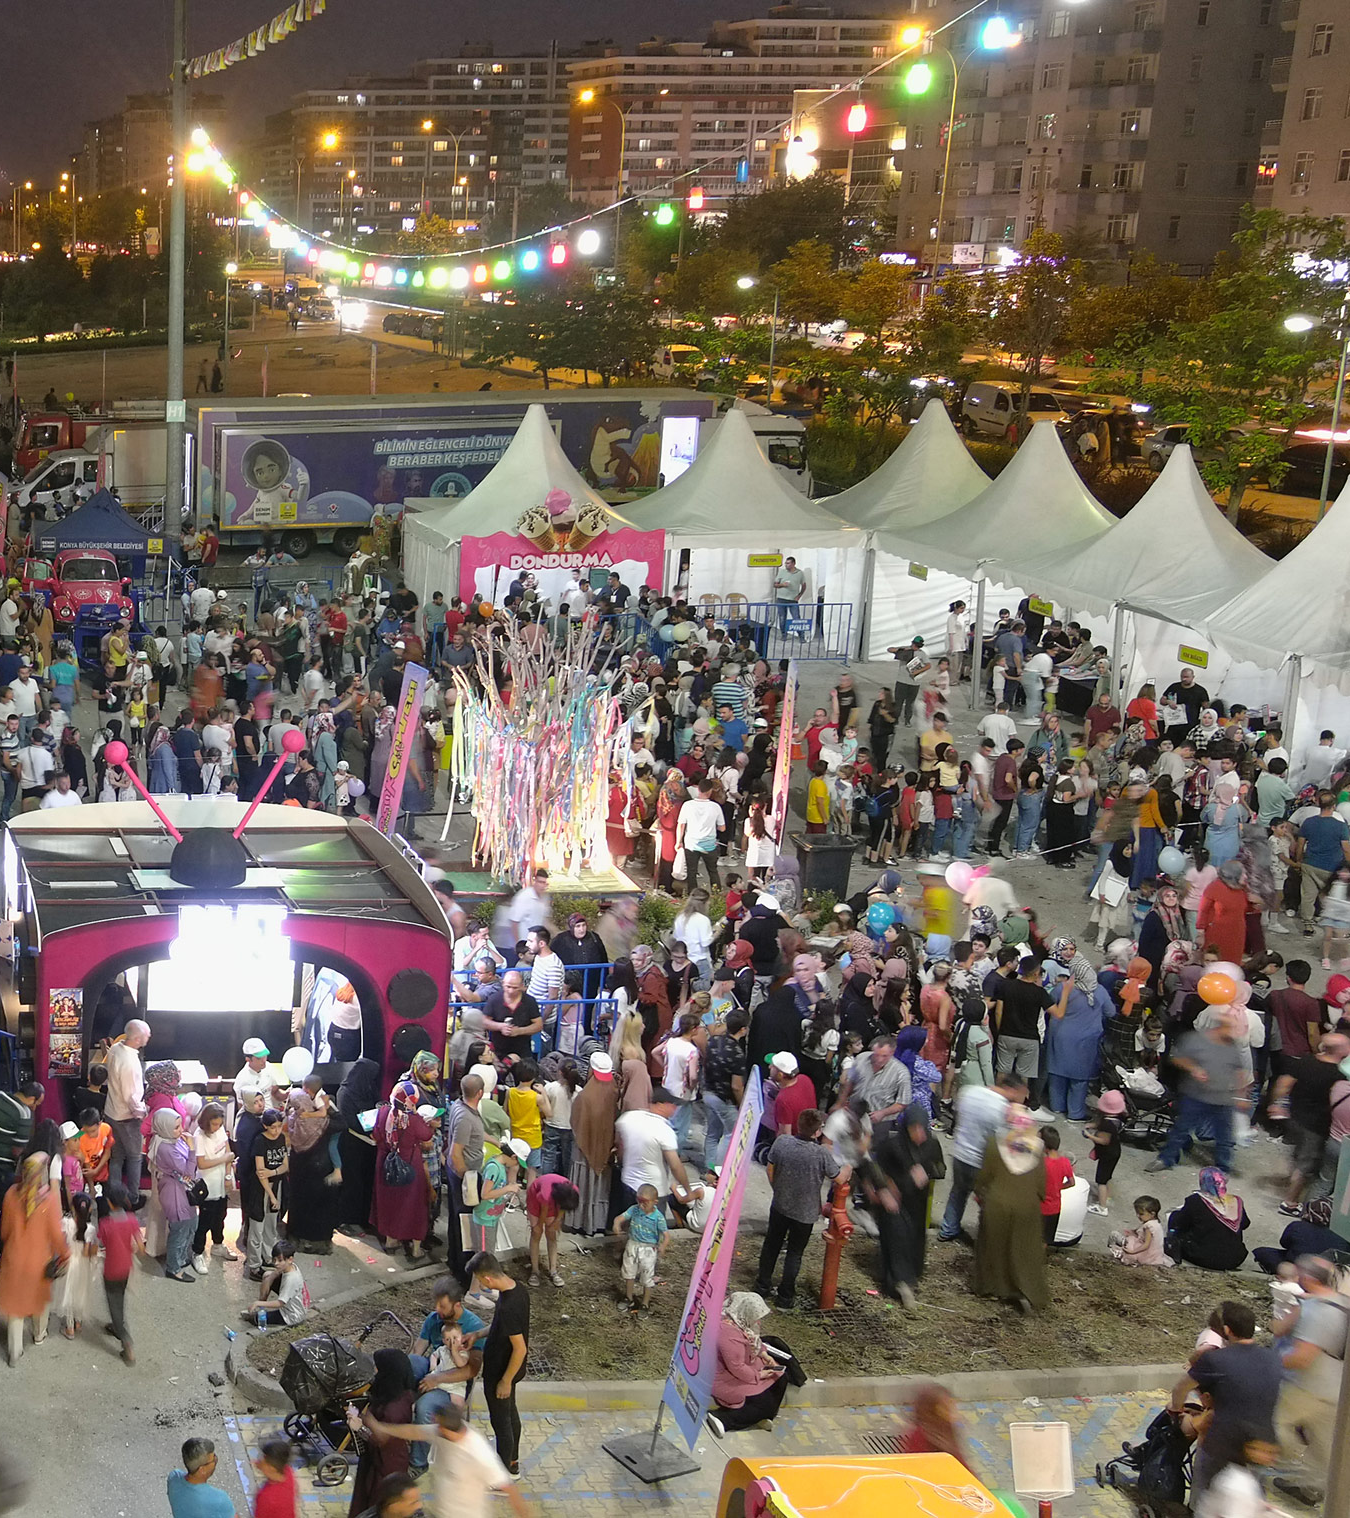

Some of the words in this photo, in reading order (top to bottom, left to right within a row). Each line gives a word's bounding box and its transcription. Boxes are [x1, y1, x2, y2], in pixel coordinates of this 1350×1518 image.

[376, 438, 416, 453] BİLİMİN
[418, 436, 475, 451] EĞLENCELİ
[476, 434, 511, 448] DÜNYA
[389, 453, 442, 467] BERABER
[443, 449, 504, 466] KEŞFEDEL
[78, 541, 112, 551] BÜYÜKŞEHİR
[113, 541, 144, 550] BELEDİYESİ
[509, 550, 614, 571] DONDURMA
[788, 623, 811, 631] POLİS
